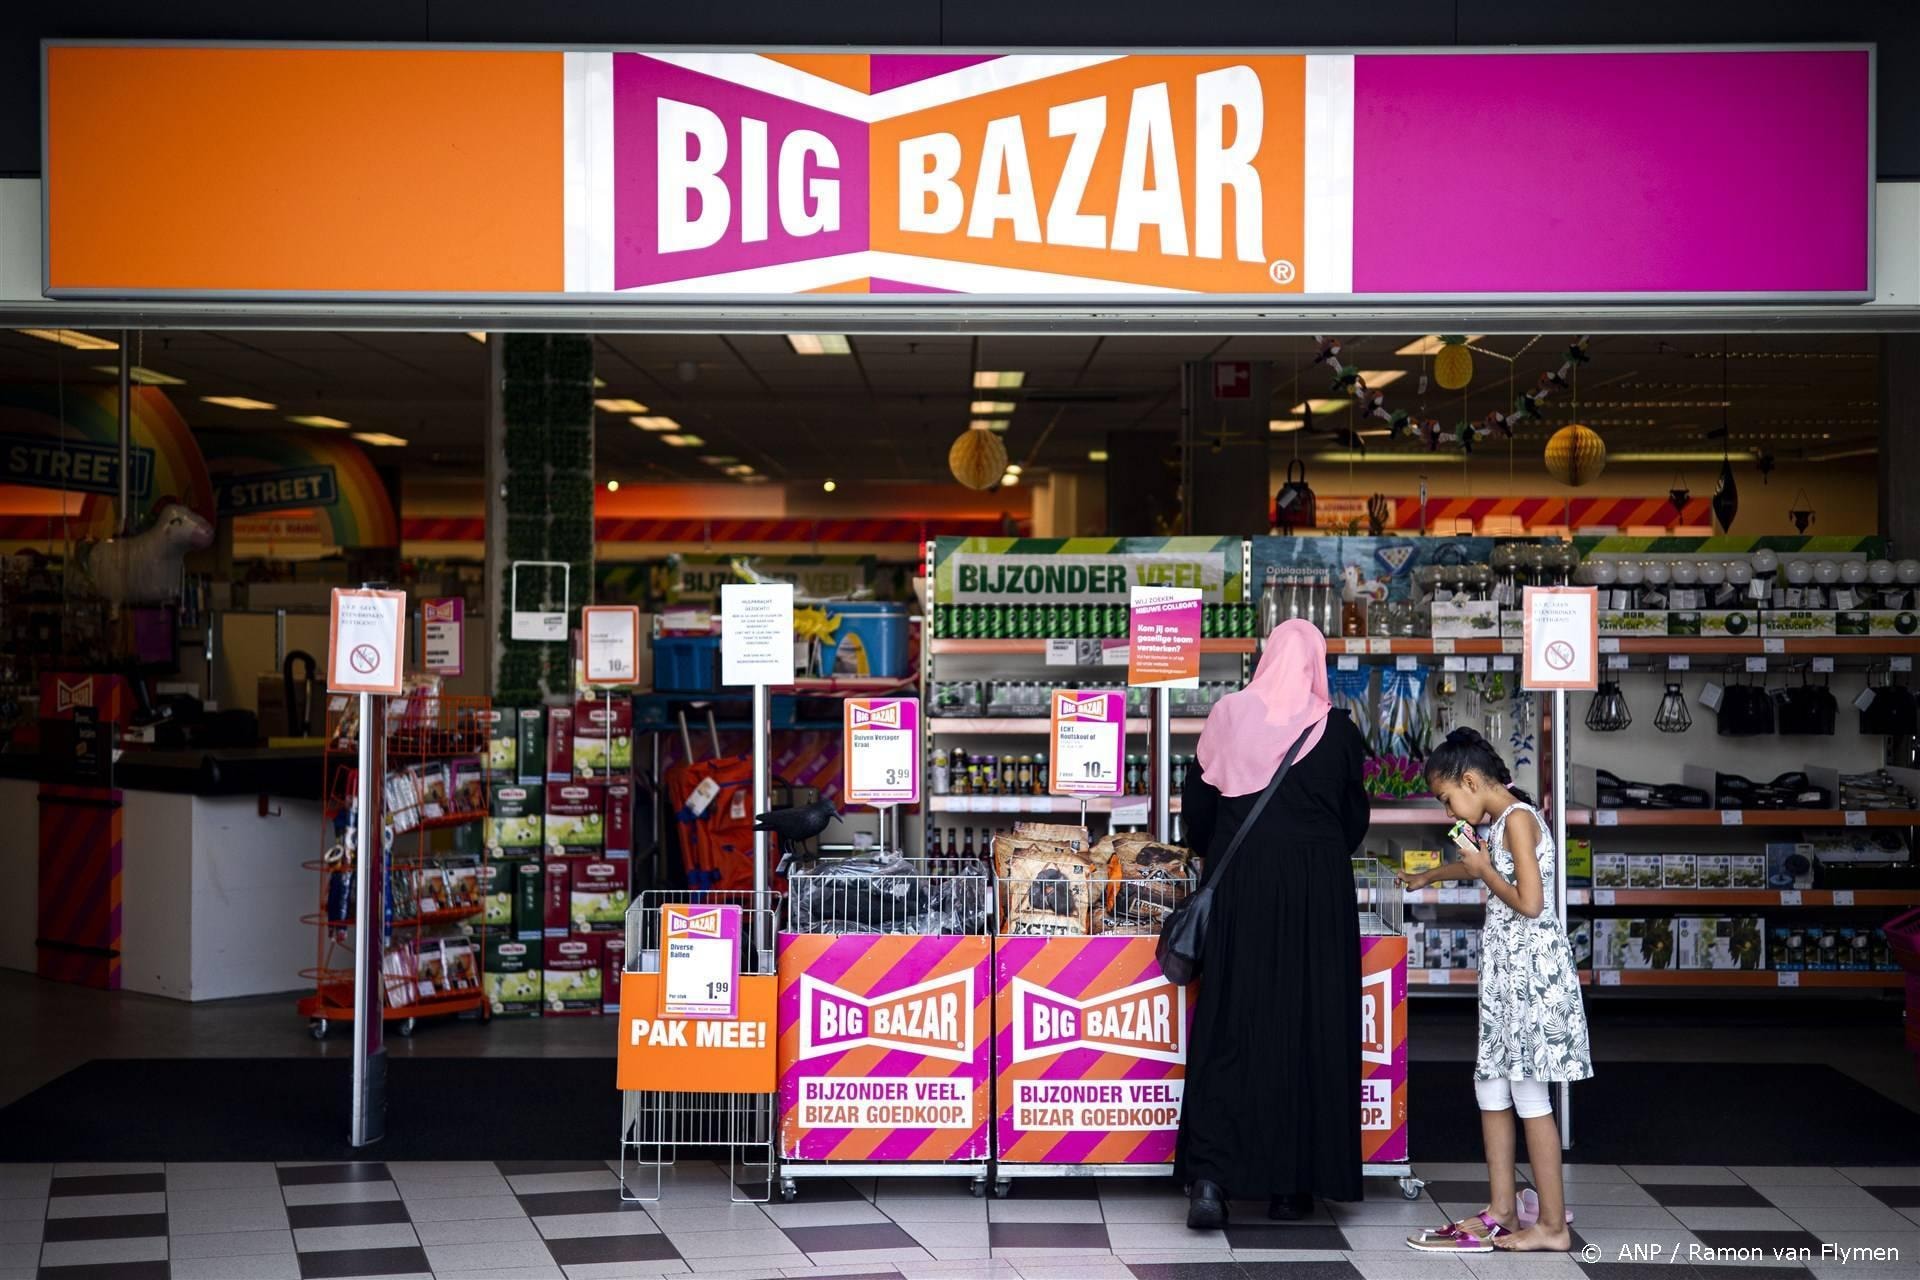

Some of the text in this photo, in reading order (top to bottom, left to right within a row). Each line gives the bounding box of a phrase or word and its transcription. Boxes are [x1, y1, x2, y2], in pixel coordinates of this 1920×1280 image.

[657, 96, 840, 254] BIG
[899, 65, 1266, 263] BAZAR
[234, 475, 322, 505] STREET
[959, 564, 1127, 593] BIJZONDER
[1135, 601, 1198, 614] NIEUWE COLLEGA'S
[1149, 595, 1174, 603] ZOEKEN
[1137, 624, 1154, 632] Kom
[1137, 634, 1172, 644] gezellige
[856, 707, 896, 724] BIG BAZAR
[1063, 700, 1103, 716] BIG BAZAR
[673, 914, 715, 932] BIG BAZAR
[820, 992, 958, 1041] BIG BAZAR
[1033, 994, 1171, 1043] BIG BAZAR
[631, 1019, 767, 1048] PAK MEE!
[806, 1083, 965, 1100] BIJZONDER VEEL.
[1021, 1085, 1180, 1103] BIJZONDER VEEL.
[806, 1106, 966, 1123] BIZAR GOEDKOOP.
[1021, 1108, 1180, 1125] BIZAR GOEDKOOP.
